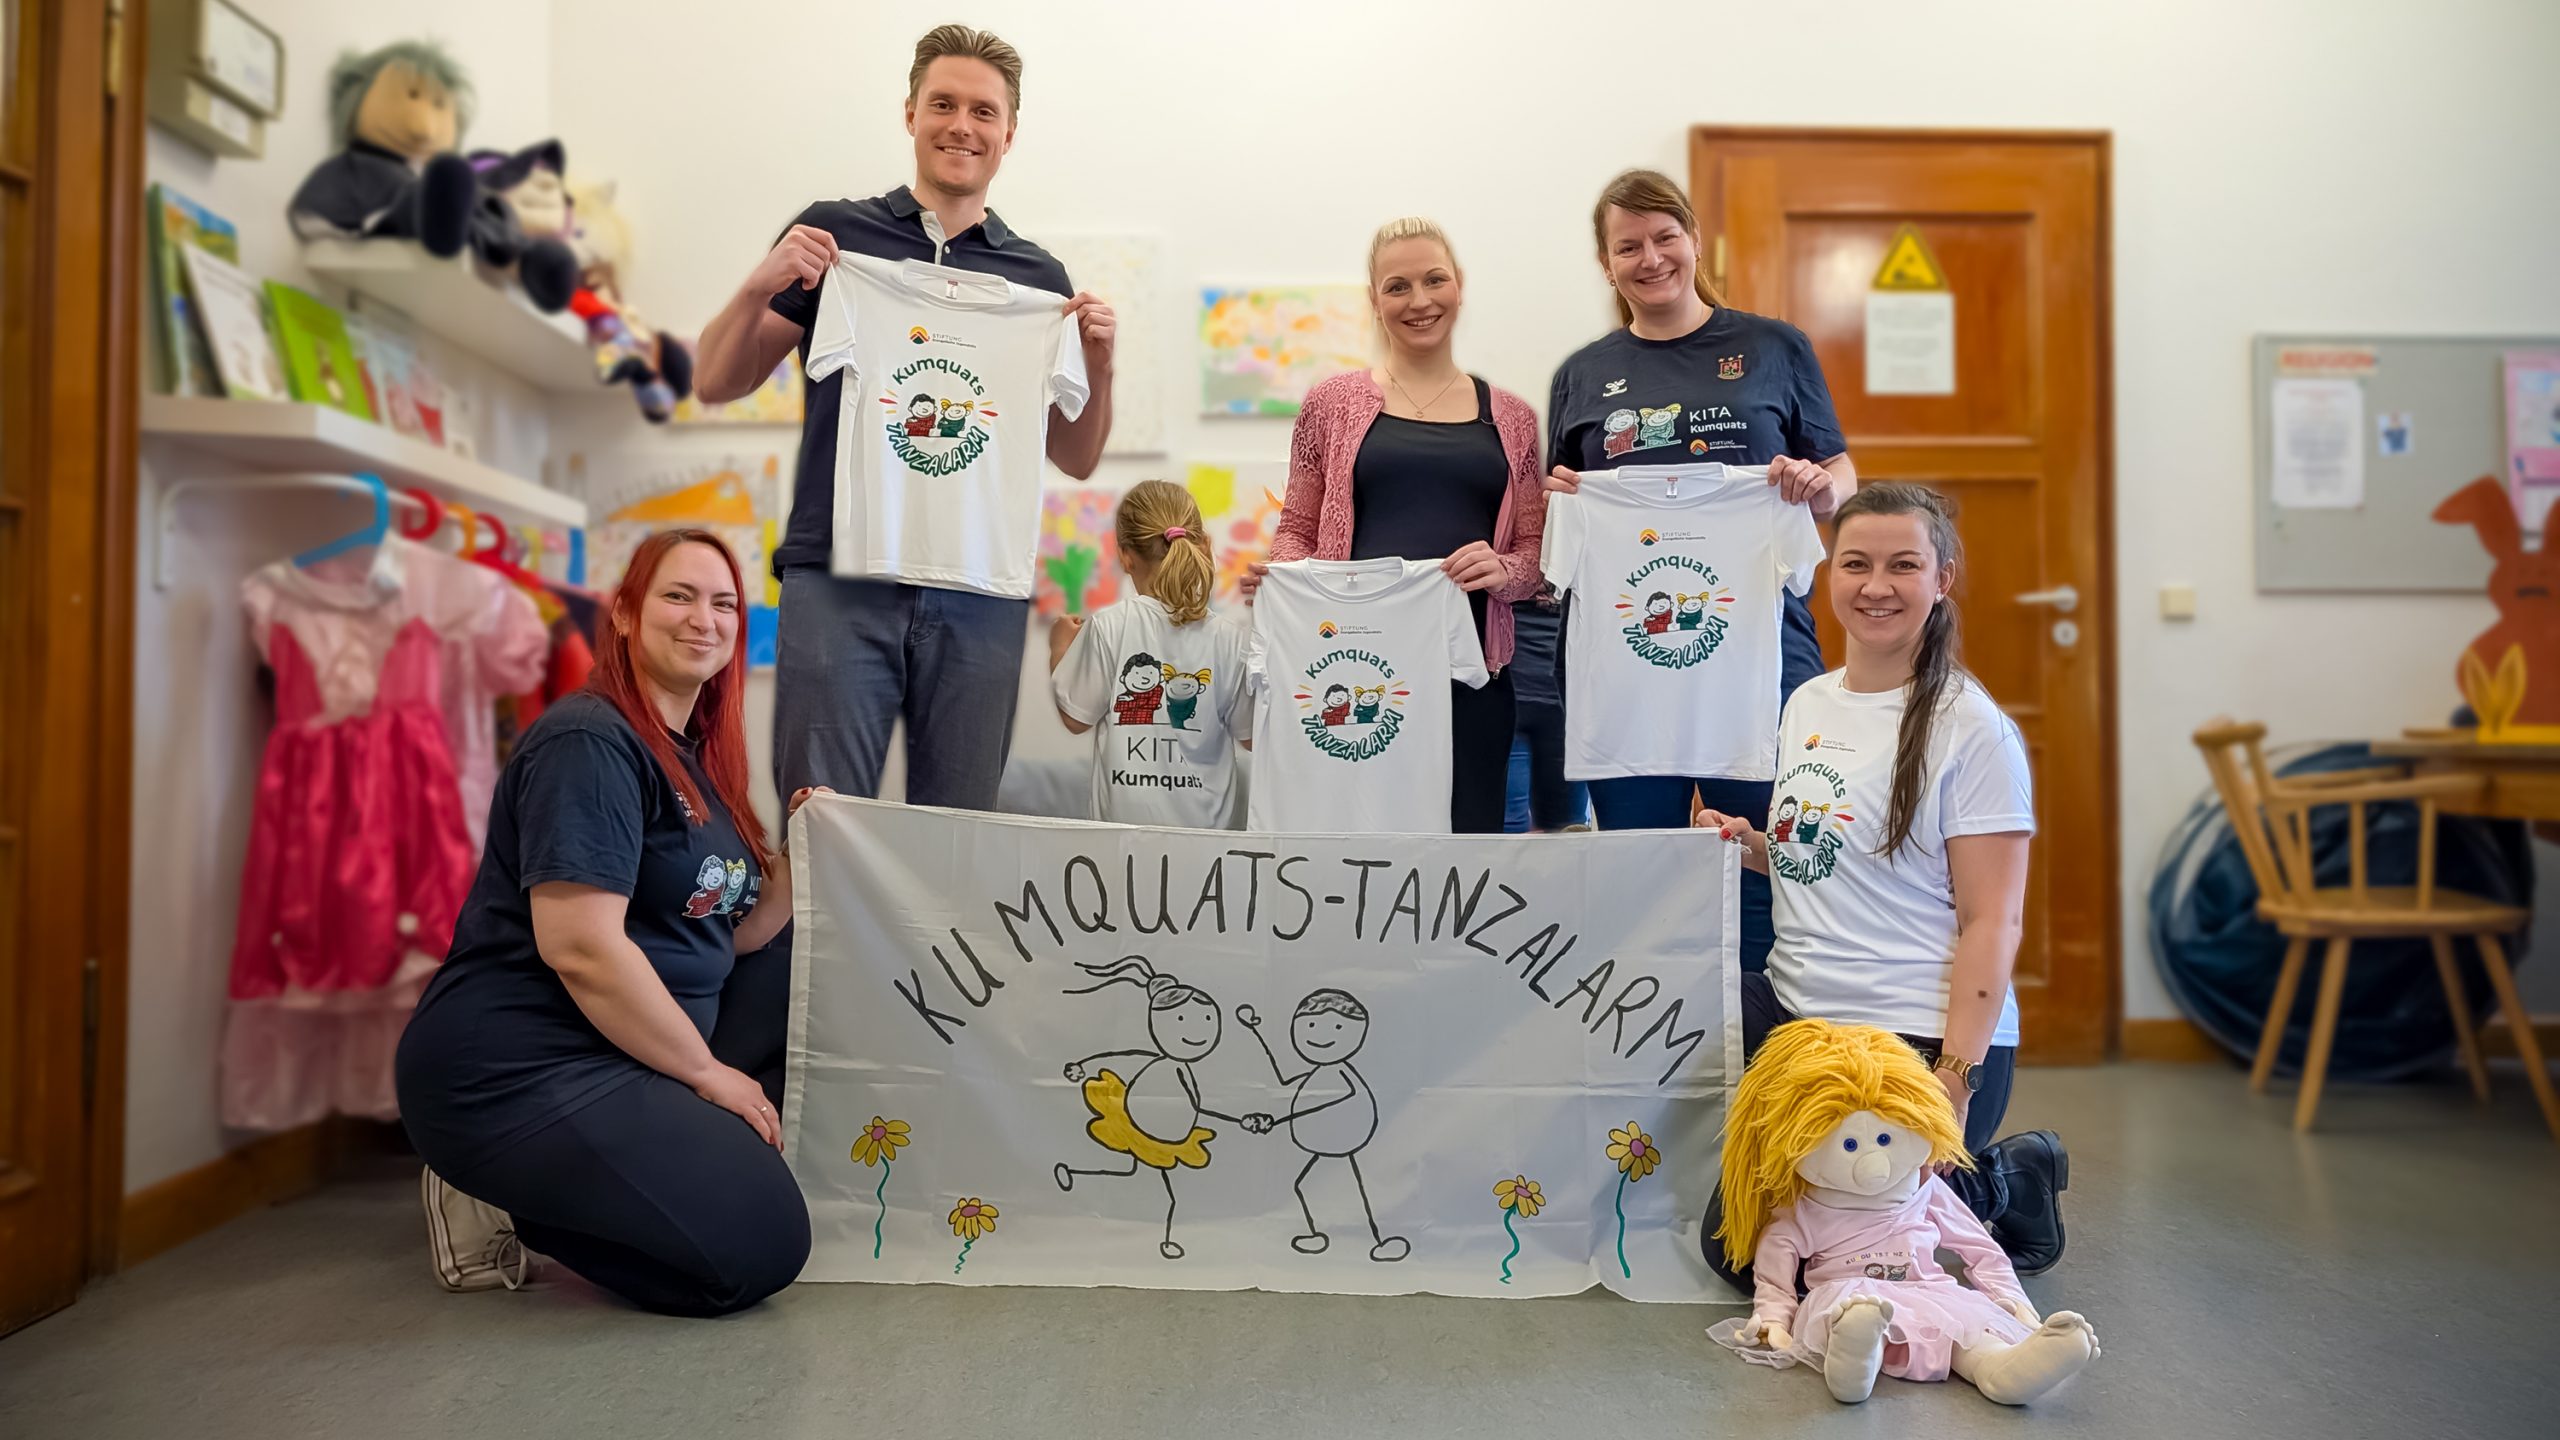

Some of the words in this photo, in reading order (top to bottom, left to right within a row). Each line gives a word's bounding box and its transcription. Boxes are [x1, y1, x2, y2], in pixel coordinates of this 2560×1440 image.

[892, 358, 985, 396] Kumquats
[1690, 406, 1732, 423] KITA
[1690, 421, 1748, 434] Kumquats
[886, 422, 990, 477] TANZALARM
[1626, 555, 1719, 588] Kumquats
[1623, 615, 1728, 669] TANZALARM
[1305, 649, 1395, 679] Kumquats
[1301, 708, 1404, 762] TANZALARM
[1778, 762, 1846, 798] Kumquats
